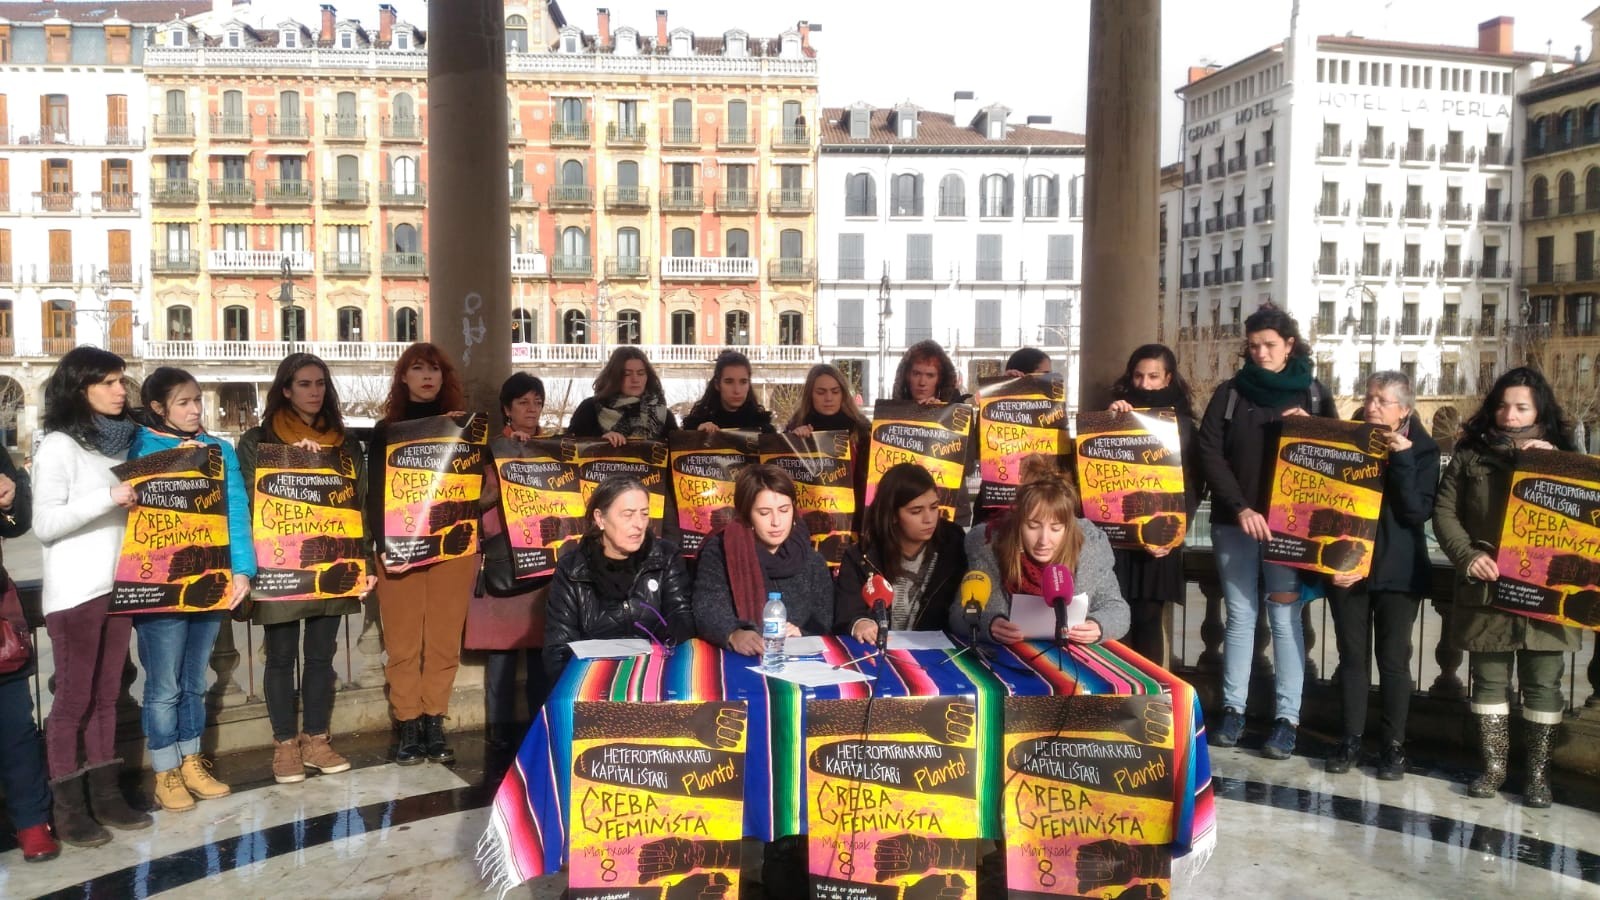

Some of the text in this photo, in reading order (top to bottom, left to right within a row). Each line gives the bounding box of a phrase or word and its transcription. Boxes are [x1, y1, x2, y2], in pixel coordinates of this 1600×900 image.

[1236, 99, 1280, 125] HOTEL
[1319, 92, 1509, 118] HOTEL LA PERLA
[999, 466, 1008, 481] 8
[1101, 505, 1111, 519] 8
[404, 517, 416, 532] 8
[692, 515, 702, 529] 8
[1287, 515, 1296, 531] 8
[523, 529, 532, 545] 8
[274, 548, 286, 565] 8
[140, 562, 152, 579] 8
[1520, 560, 1531, 577] 8
[682, 758, 738, 795] Planto!
[914, 754, 969, 791] Planto!
[1114, 755, 1168, 793] Planto!
[601, 859, 617, 881] 8
[839, 852, 855, 875] 8
[1038, 860, 1056, 887] 8
